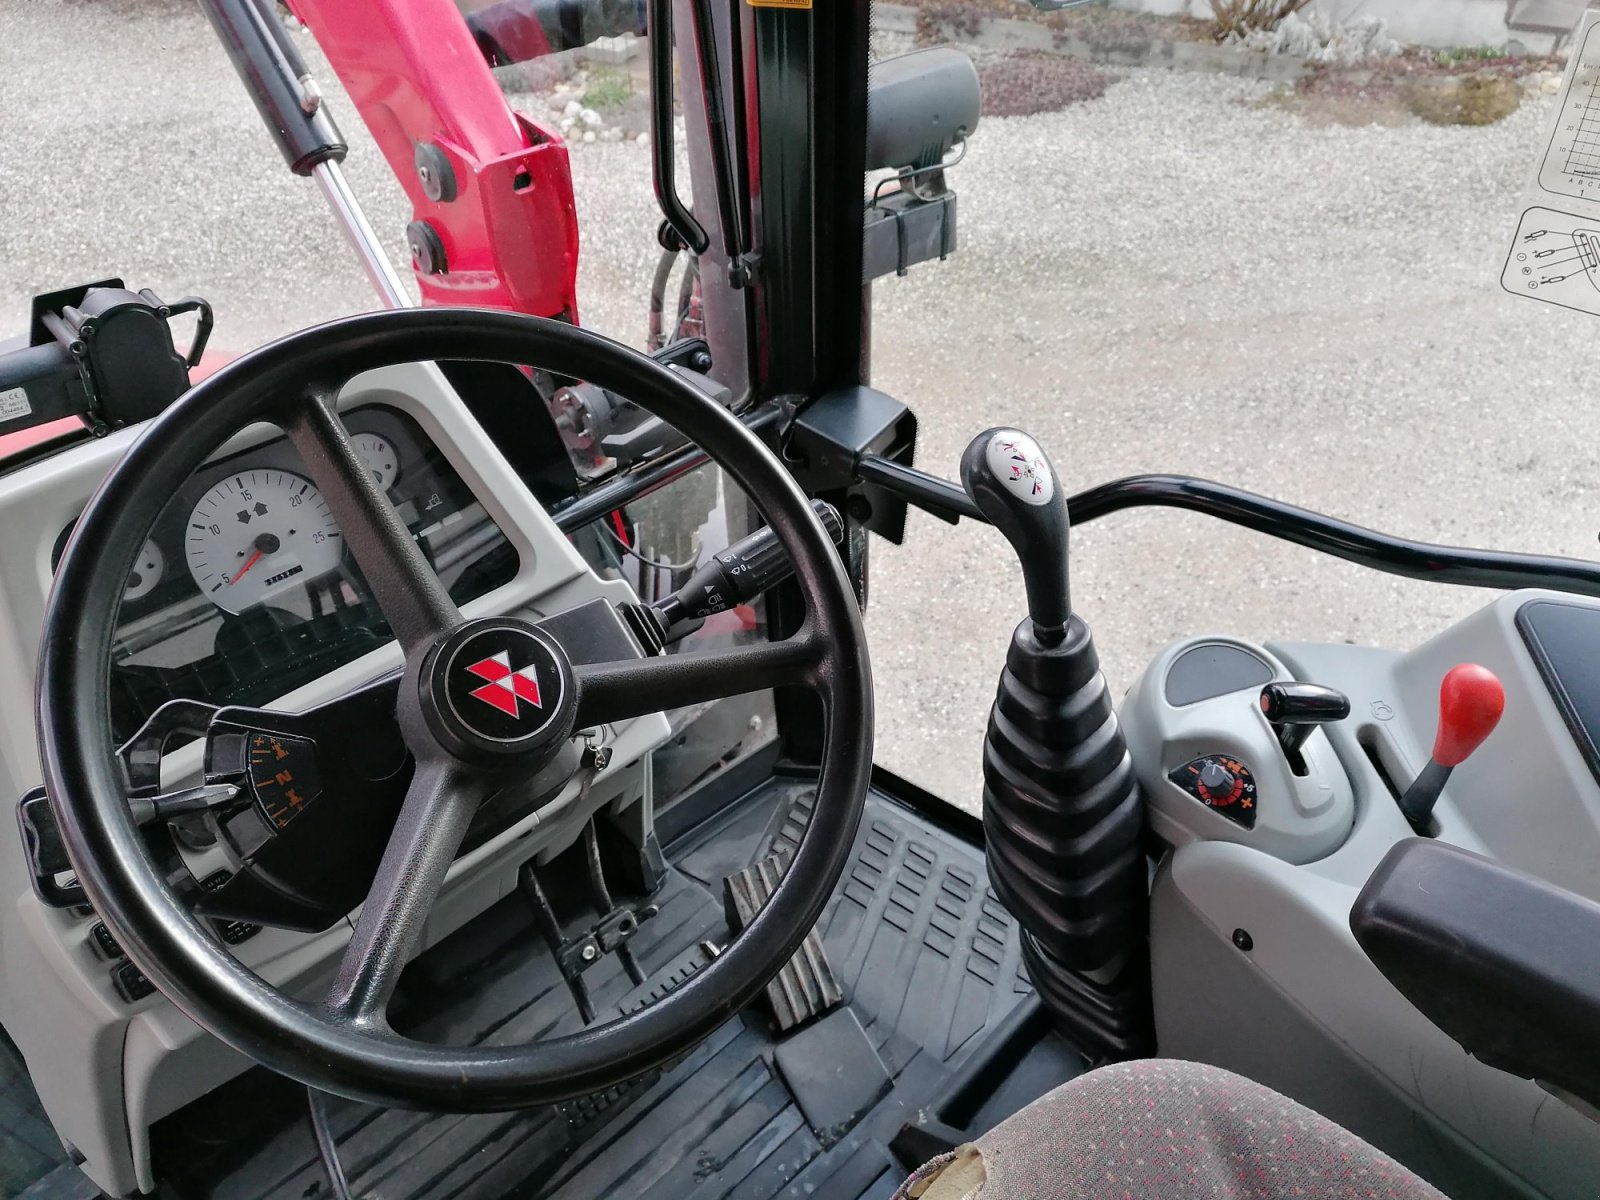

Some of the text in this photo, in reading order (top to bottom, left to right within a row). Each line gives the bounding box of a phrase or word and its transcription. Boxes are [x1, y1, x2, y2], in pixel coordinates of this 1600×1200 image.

[241, 490, 252, 502] 15
[289, 494, 303, 508] 20
[208, 523, 221, 536] 10
[312, 532, 326, 544] 25
[221, 573, 231, 584] 5
